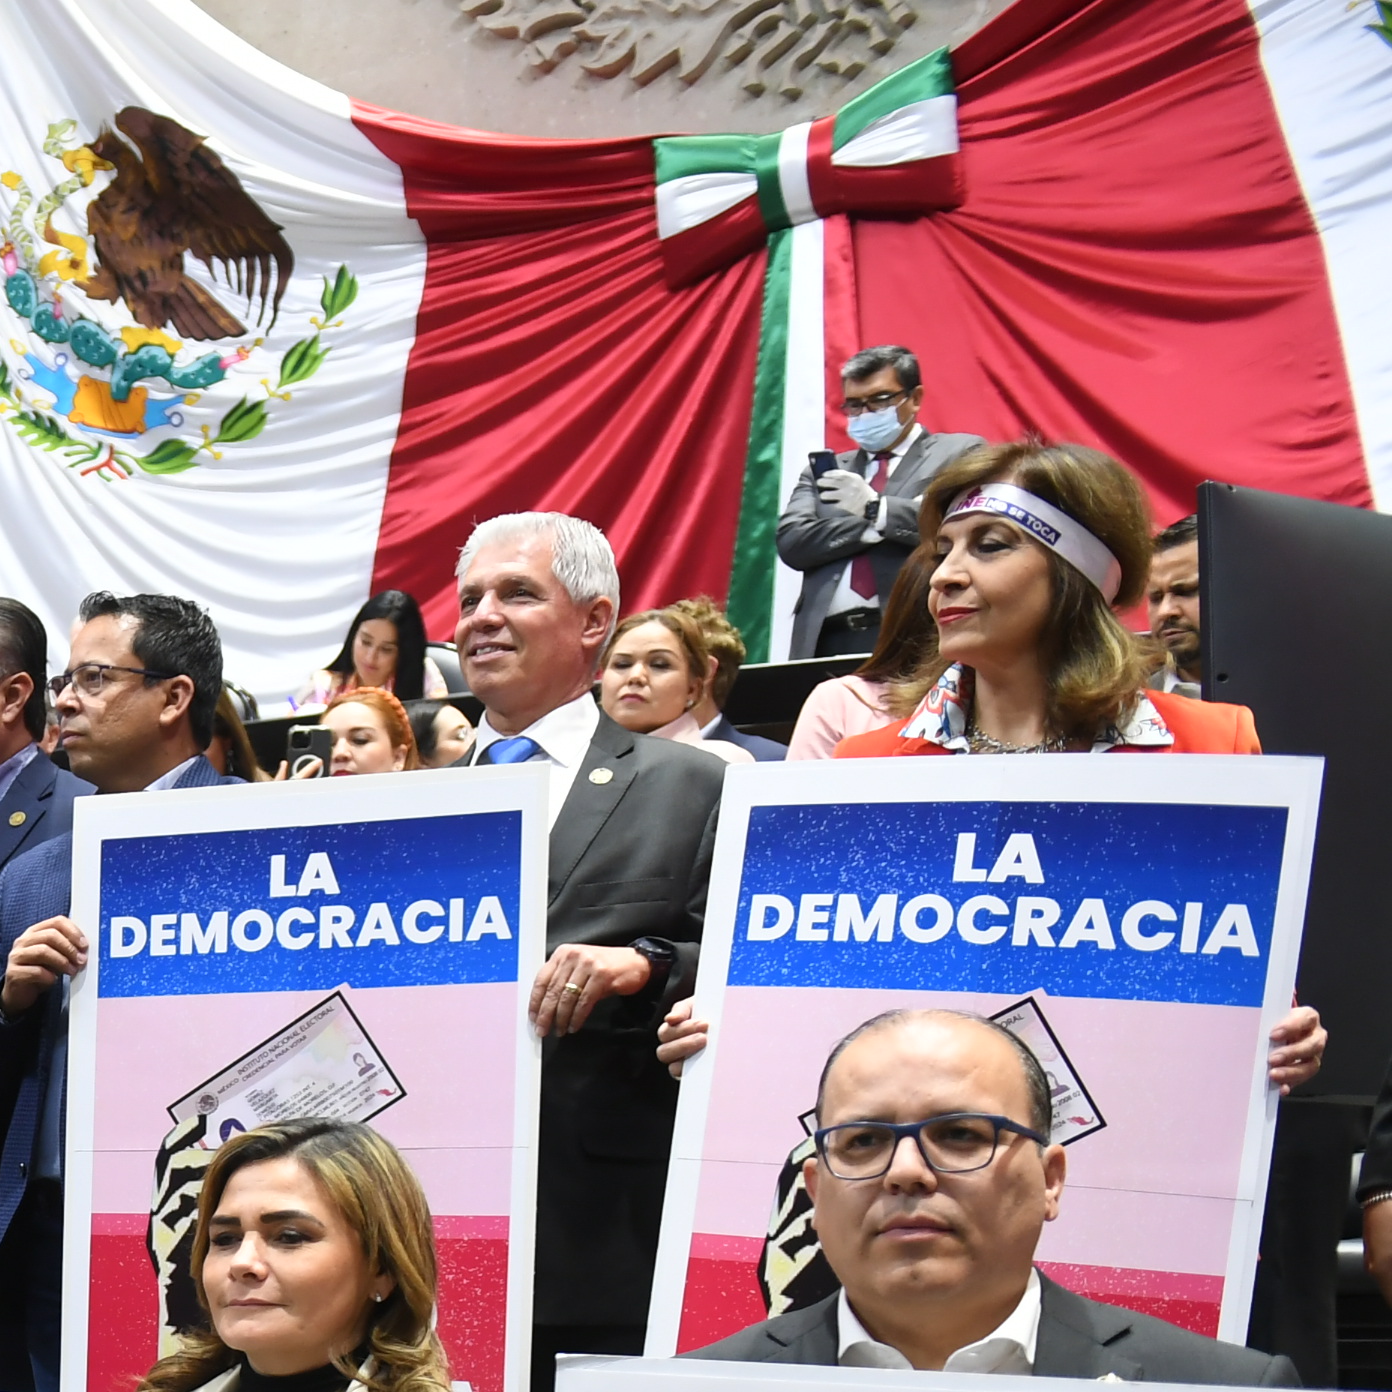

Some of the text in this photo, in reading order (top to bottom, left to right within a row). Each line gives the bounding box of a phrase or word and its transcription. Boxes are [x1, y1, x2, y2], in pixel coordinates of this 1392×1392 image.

[1008, 507, 1025, 521] SE
[1026, 515, 1056, 543] TOCA
[270, 852, 340, 897] LA
[953, 833, 1044, 883] LA
[111, 897, 511, 957] DEMOCRACIA
[747, 894, 1259, 956] DEMOCRACIA
